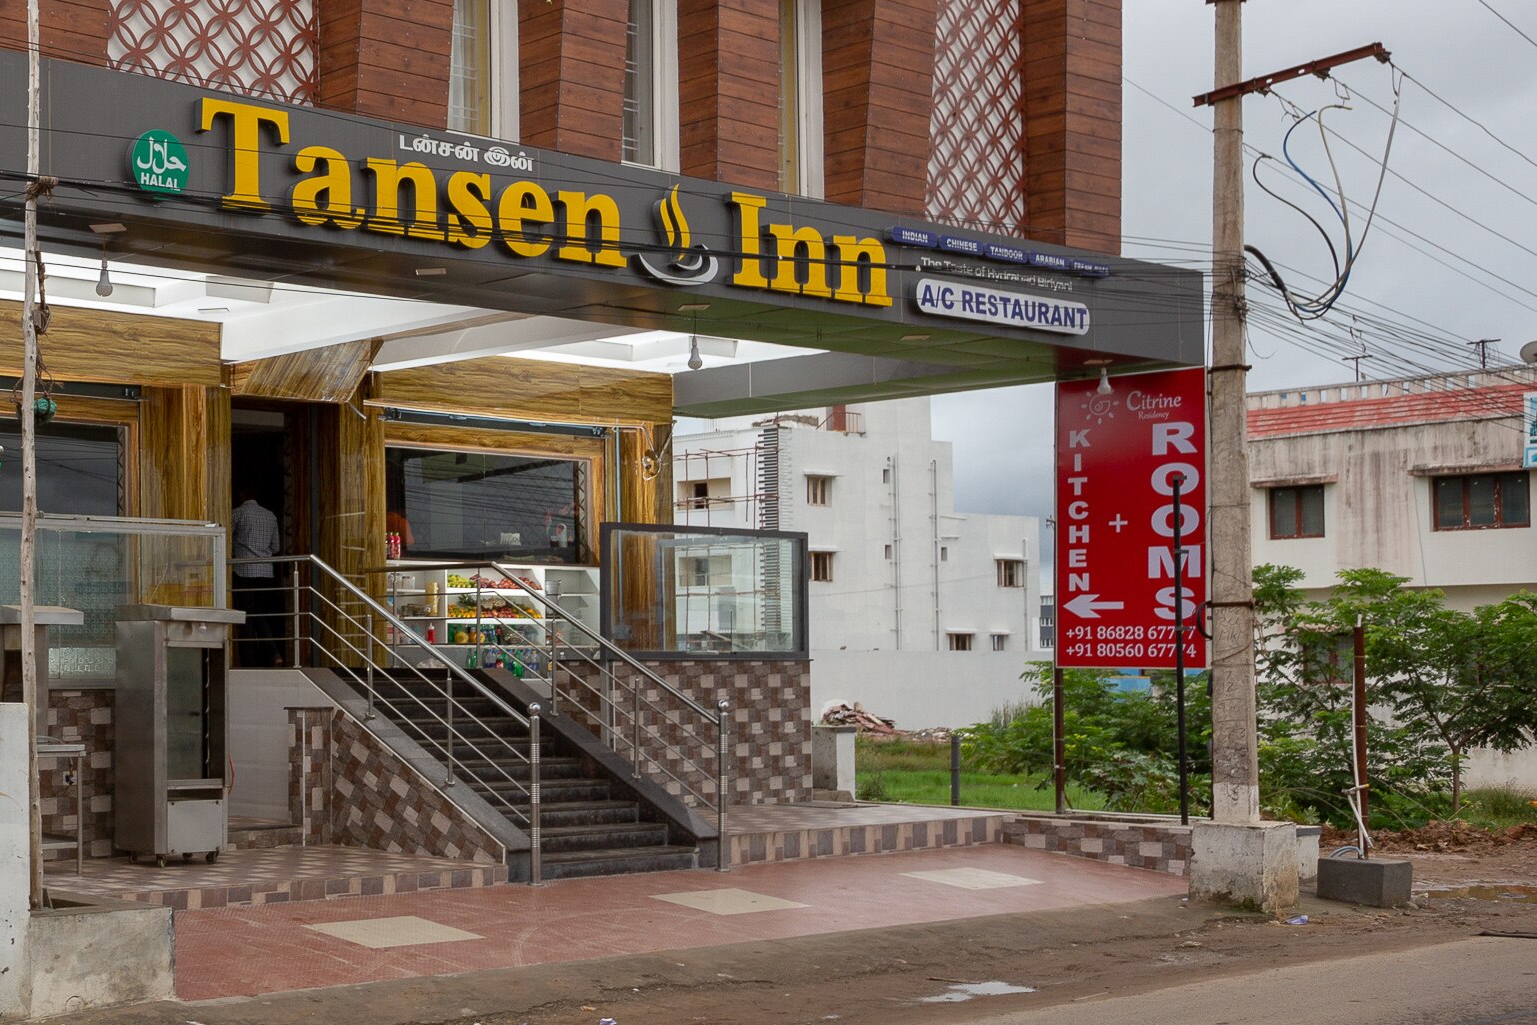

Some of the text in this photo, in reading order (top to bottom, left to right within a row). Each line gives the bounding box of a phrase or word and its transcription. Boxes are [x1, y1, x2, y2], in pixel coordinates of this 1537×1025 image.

[483, 146, 534, 172] இன்
[140, 172, 181, 192] HALAL
[196, 96, 892, 308] Tansen Inn
[902, 230, 929, 243] INDIAN
[946, 238, 978, 252] CHINESE
[990, 245, 1024, 261] TANDOOR
[1035, 253, 1065, 267] ARABIAN
[975, 265, 985, 277] of
[920, 284, 1087, 330] A/C RESTAURANT
[1126, 390, 1182, 412] Citrine
[1138, 410, 1170, 421] Residency
[1067, 429, 1091, 592] KITCHEN
[1147, 421, 1201, 621] ROOMS
[1066, 626, 1094, 641] +91
[1097, 625, 1144, 641] 86828
[1148, 625, 1196, 641] 6777
[1066, 643, 1094, 658] +91
[1097, 642, 1144, 658] 80560
